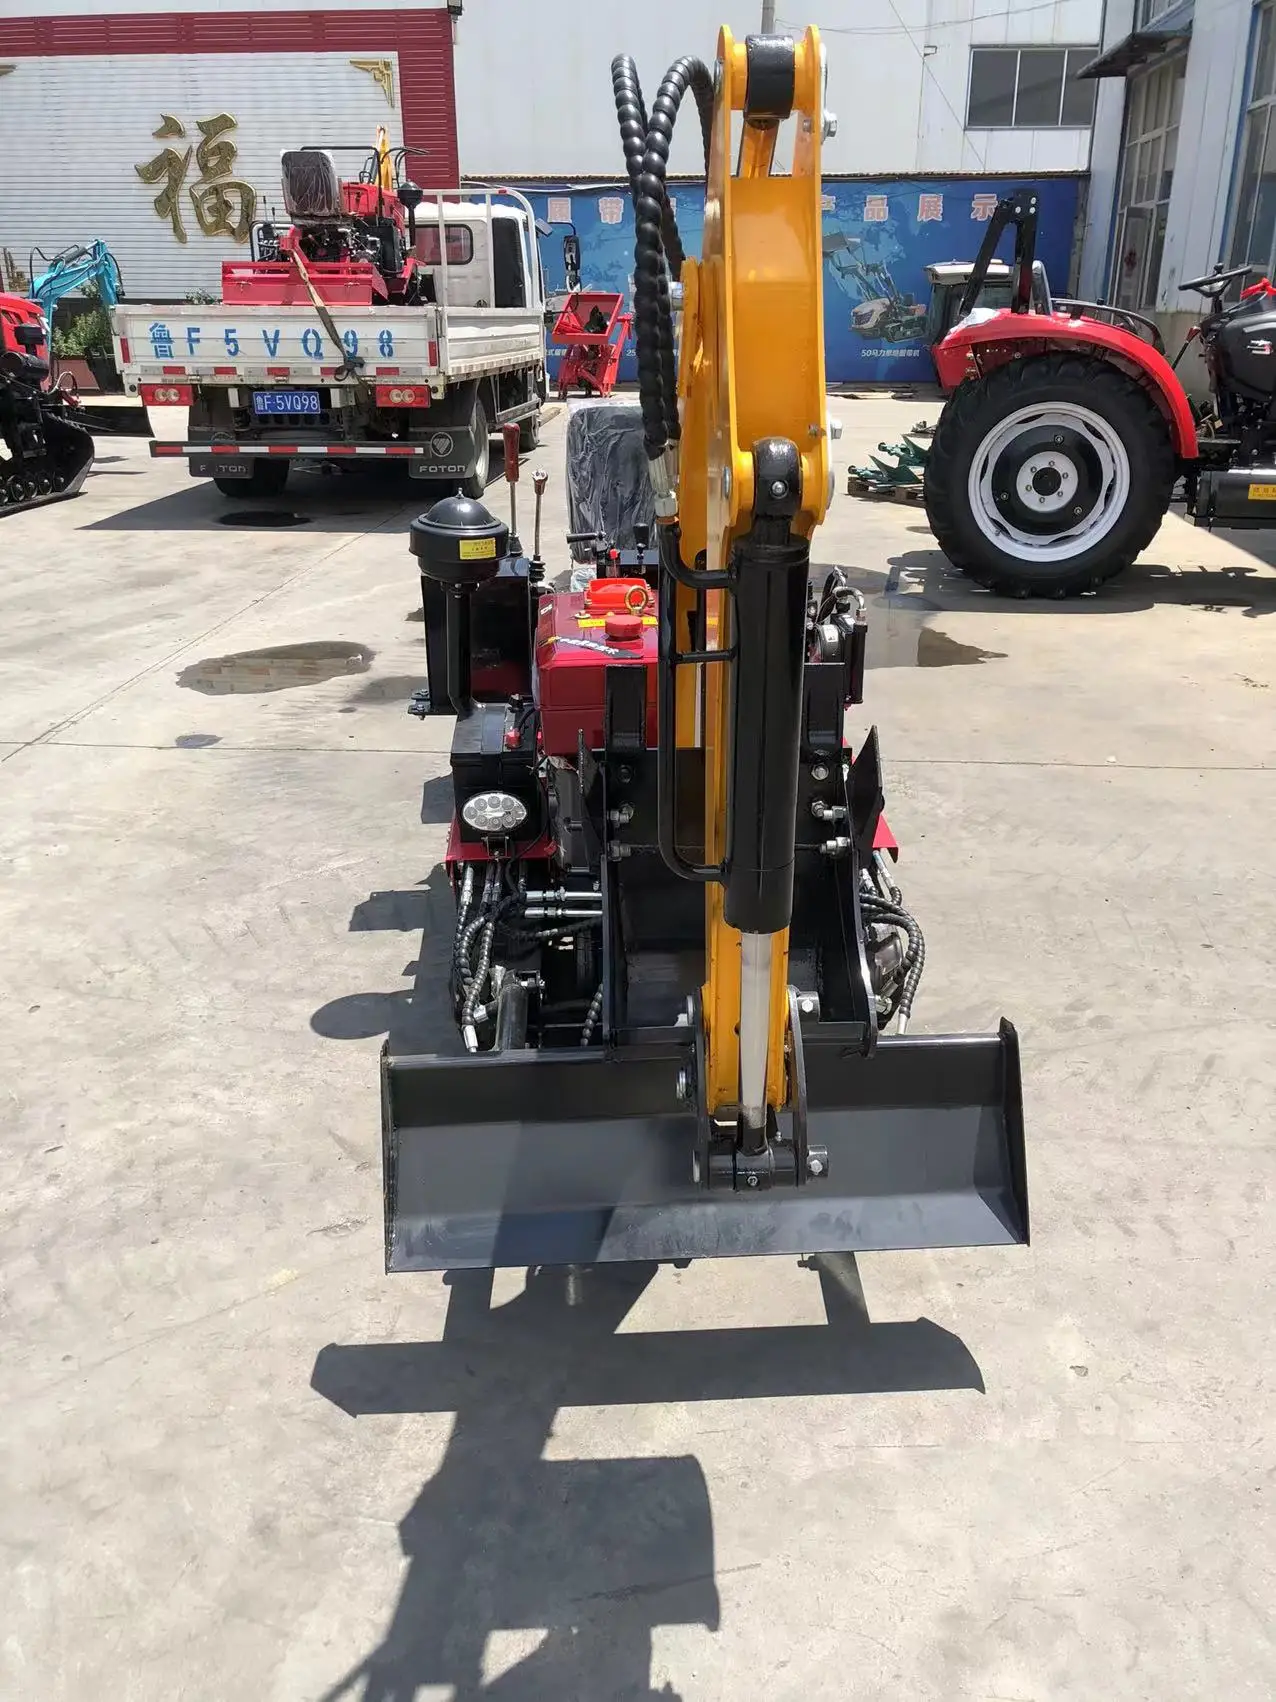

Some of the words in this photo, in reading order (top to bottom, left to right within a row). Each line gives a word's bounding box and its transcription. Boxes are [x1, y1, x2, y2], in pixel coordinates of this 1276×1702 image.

[134, 112, 257, 244] 福
[200, 464, 247, 473] FTON
[419, 465, 466, 473] FOTON
